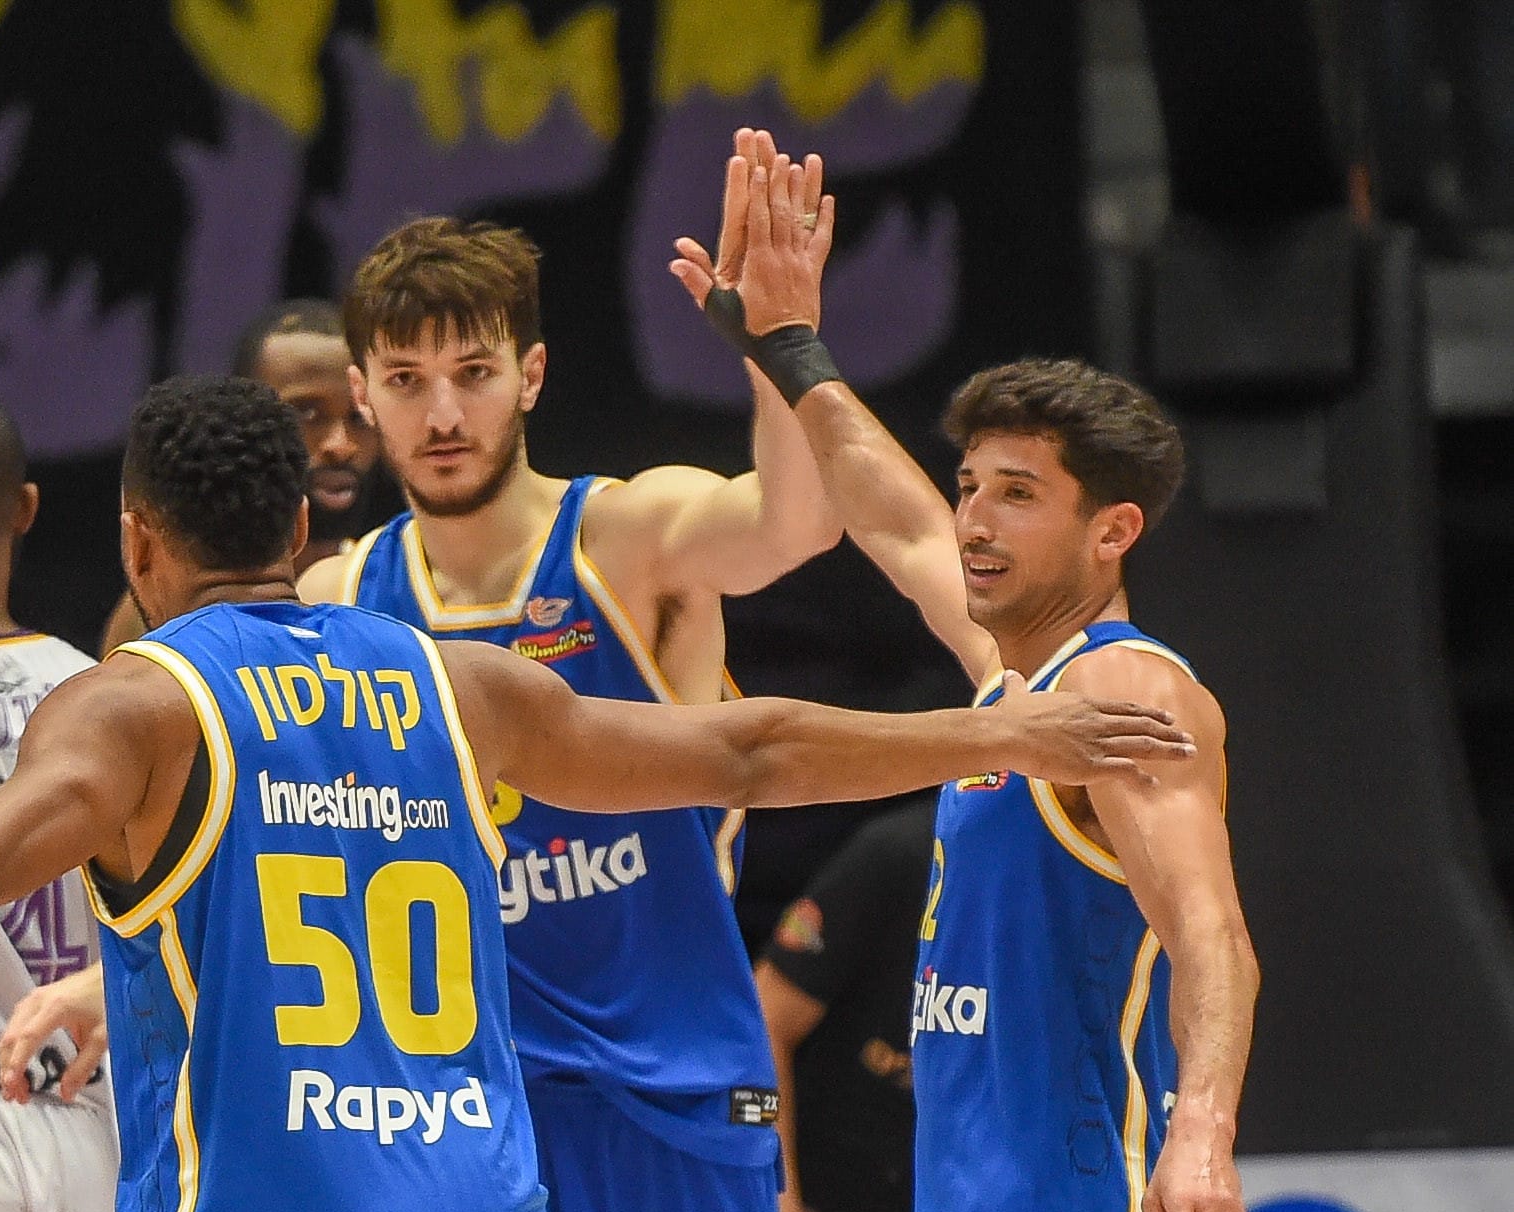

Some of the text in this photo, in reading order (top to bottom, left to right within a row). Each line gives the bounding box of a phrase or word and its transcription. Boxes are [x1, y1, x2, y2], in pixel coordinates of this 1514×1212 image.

[520, 637, 579, 659] Winner
[236, 654, 421, 751] קולסון
[258, 770, 449, 842] Investing.com
[920, 837, 945, 941] 2
[256, 853, 478, 1056] 50
[910, 966, 988, 1048] tika
[287, 1070, 493, 1145] Rapyd
